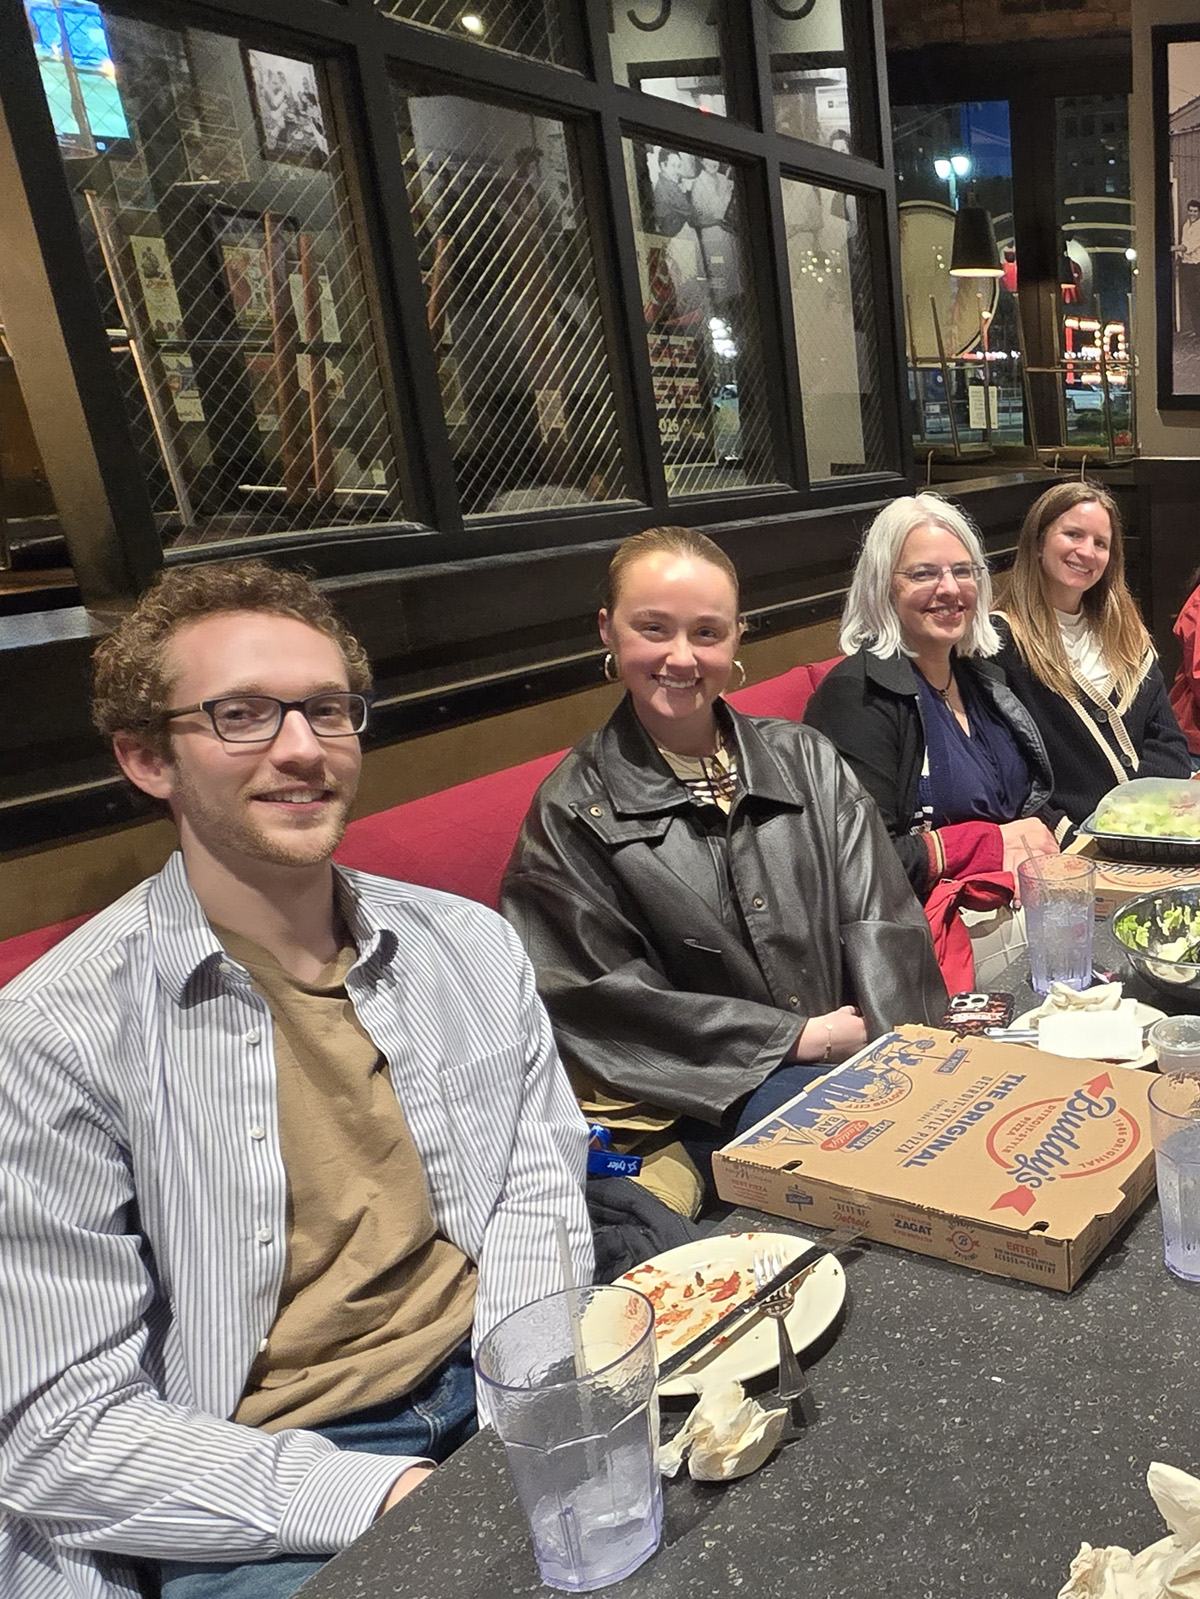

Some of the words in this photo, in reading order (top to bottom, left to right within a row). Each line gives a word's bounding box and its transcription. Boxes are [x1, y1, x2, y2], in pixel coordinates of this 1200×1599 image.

[986, 1074, 1027, 1100] THE
[924, 1076, 994, 1131] DETROIT-STYLE
[814, 1116, 840, 1132] BAR
[826, 1122, 866, 1148] Buddy's
[853, 1120, 893, 1147] PIZZERIA
[902, 1101, 994, 1168] ORIGINAL
[1002, 1104, 1057, 1154] DETROIT-STYLE
[1006, 1116, 1032, 1136] PIZZA
[894, 1132, 929, 1154] PIZZA
[1006, 1089, 1116, 1188] Buddy's
[1078, 1138, 1126, 1169] ORIGINAL
[832, 1211, 871, 1228] Detroit
[894, 1218, 932, 1236] ZAGAT
[1006, 1241, 1038, 1257] EATER
